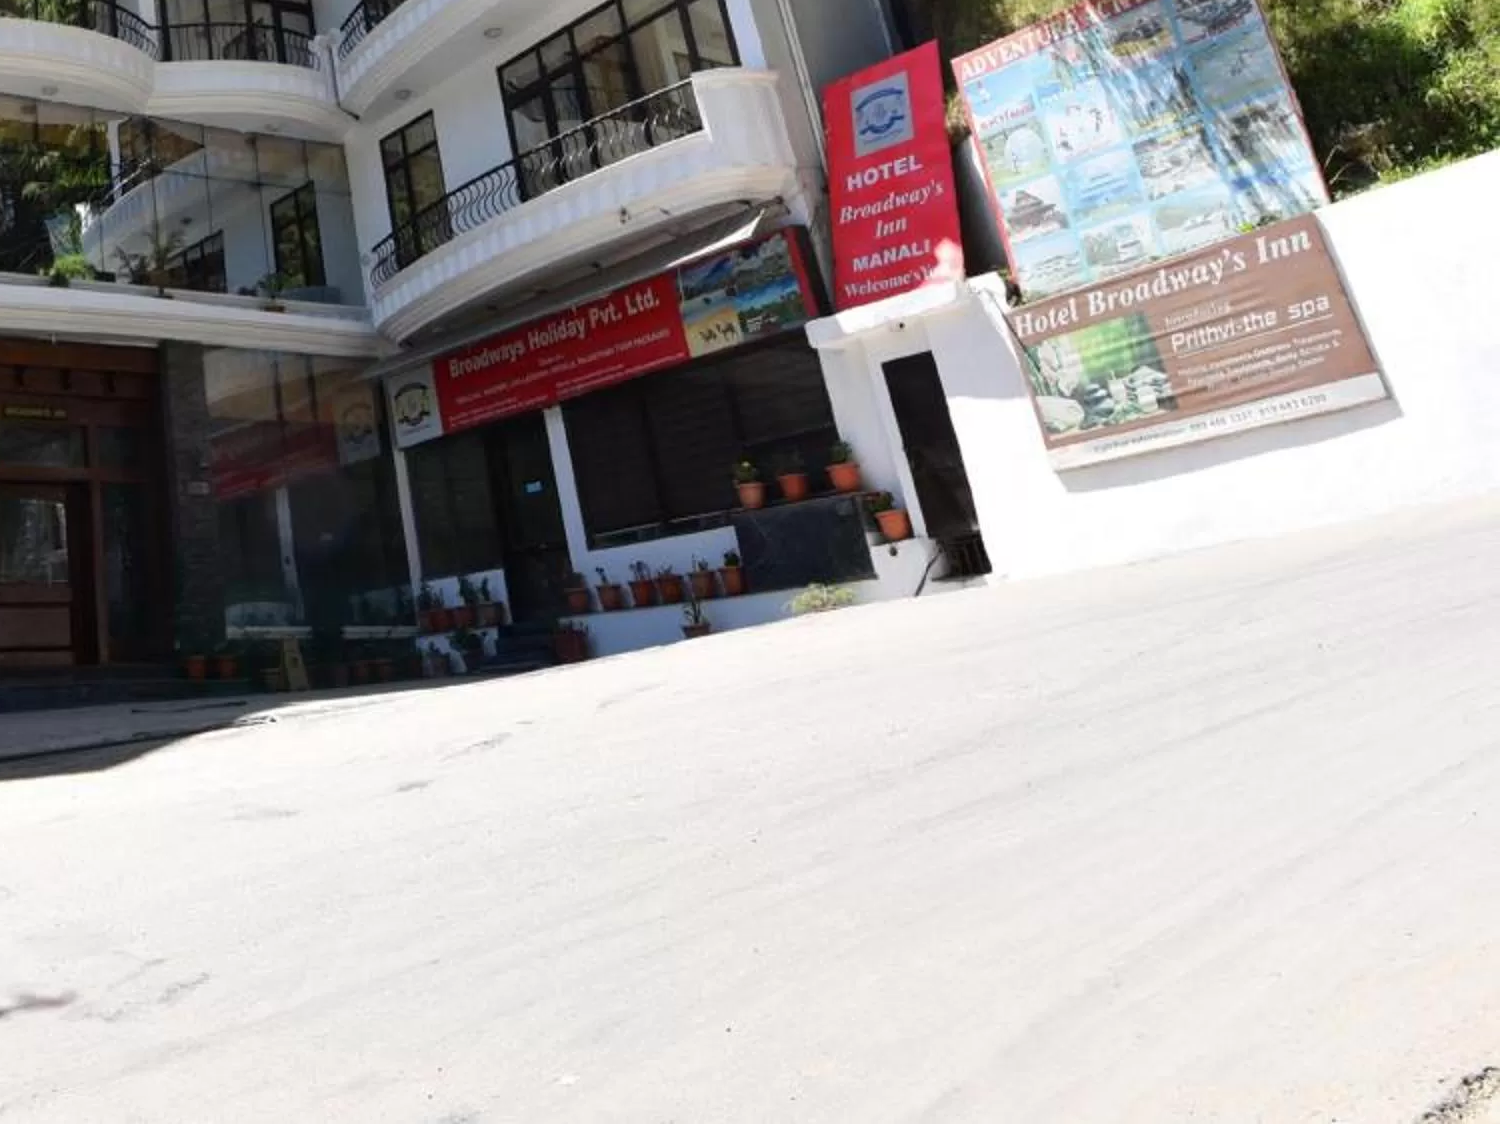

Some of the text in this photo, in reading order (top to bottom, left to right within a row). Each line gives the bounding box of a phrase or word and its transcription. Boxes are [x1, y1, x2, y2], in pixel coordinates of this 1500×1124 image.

[846, 154, 924, 192] HOTEL
[839, 179, 945, 225] Broadway's
[874, 216, 908, 240] Inn
[852, 238, 932, 273] MANALI
[844, 268, 922, 298] Welcome's
[1014, 229, 1313, 340] Hotel Broadway's Inn
[1287, 294, 1332, 323] spa
[448, 338, 525, 379] Broadways
[527, 314, 587, 350] Holiday
[590, 301, 623, 329] Pvt.
[624, 287, 660, 317] Ltd.
